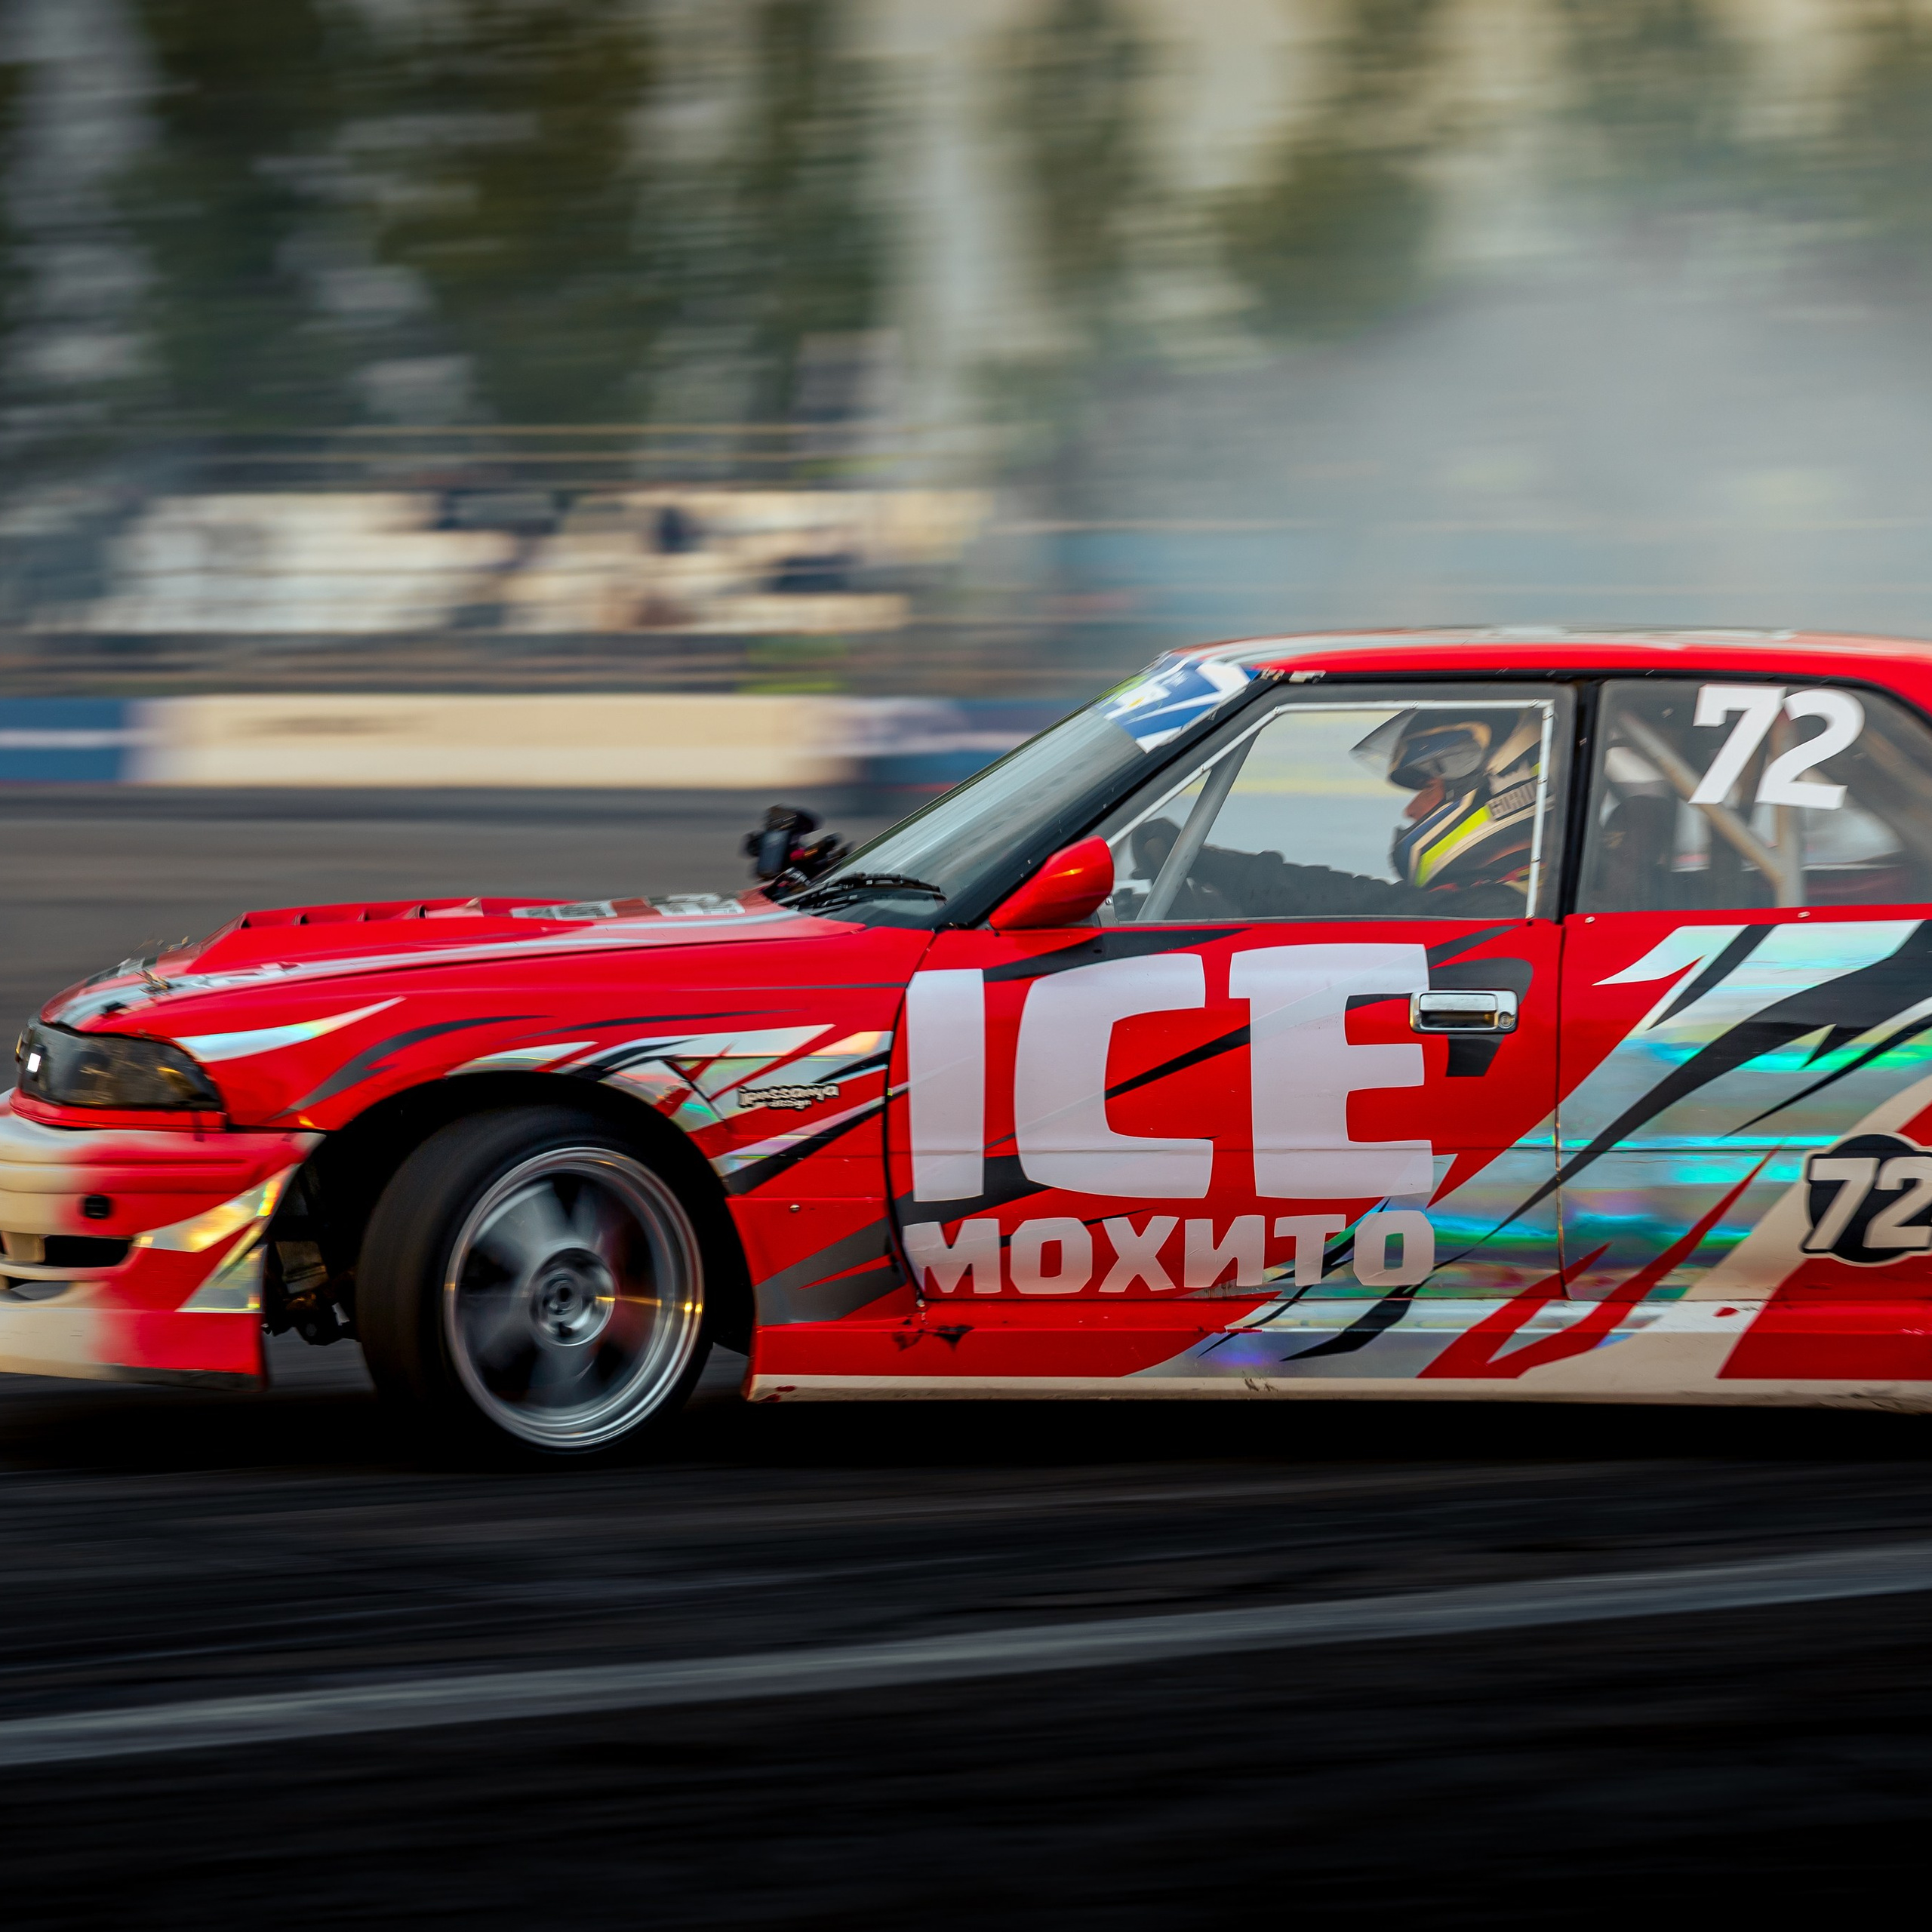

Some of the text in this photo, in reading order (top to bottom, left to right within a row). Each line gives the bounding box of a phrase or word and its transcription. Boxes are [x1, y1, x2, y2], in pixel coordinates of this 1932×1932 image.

[1687, 684, 1866, 811] 72
[906, 943, 1433, 1201] ICE
[903, 1210, 1435, 1294] МОХИТО
[1802, 1156, 1932, 1250] 72
